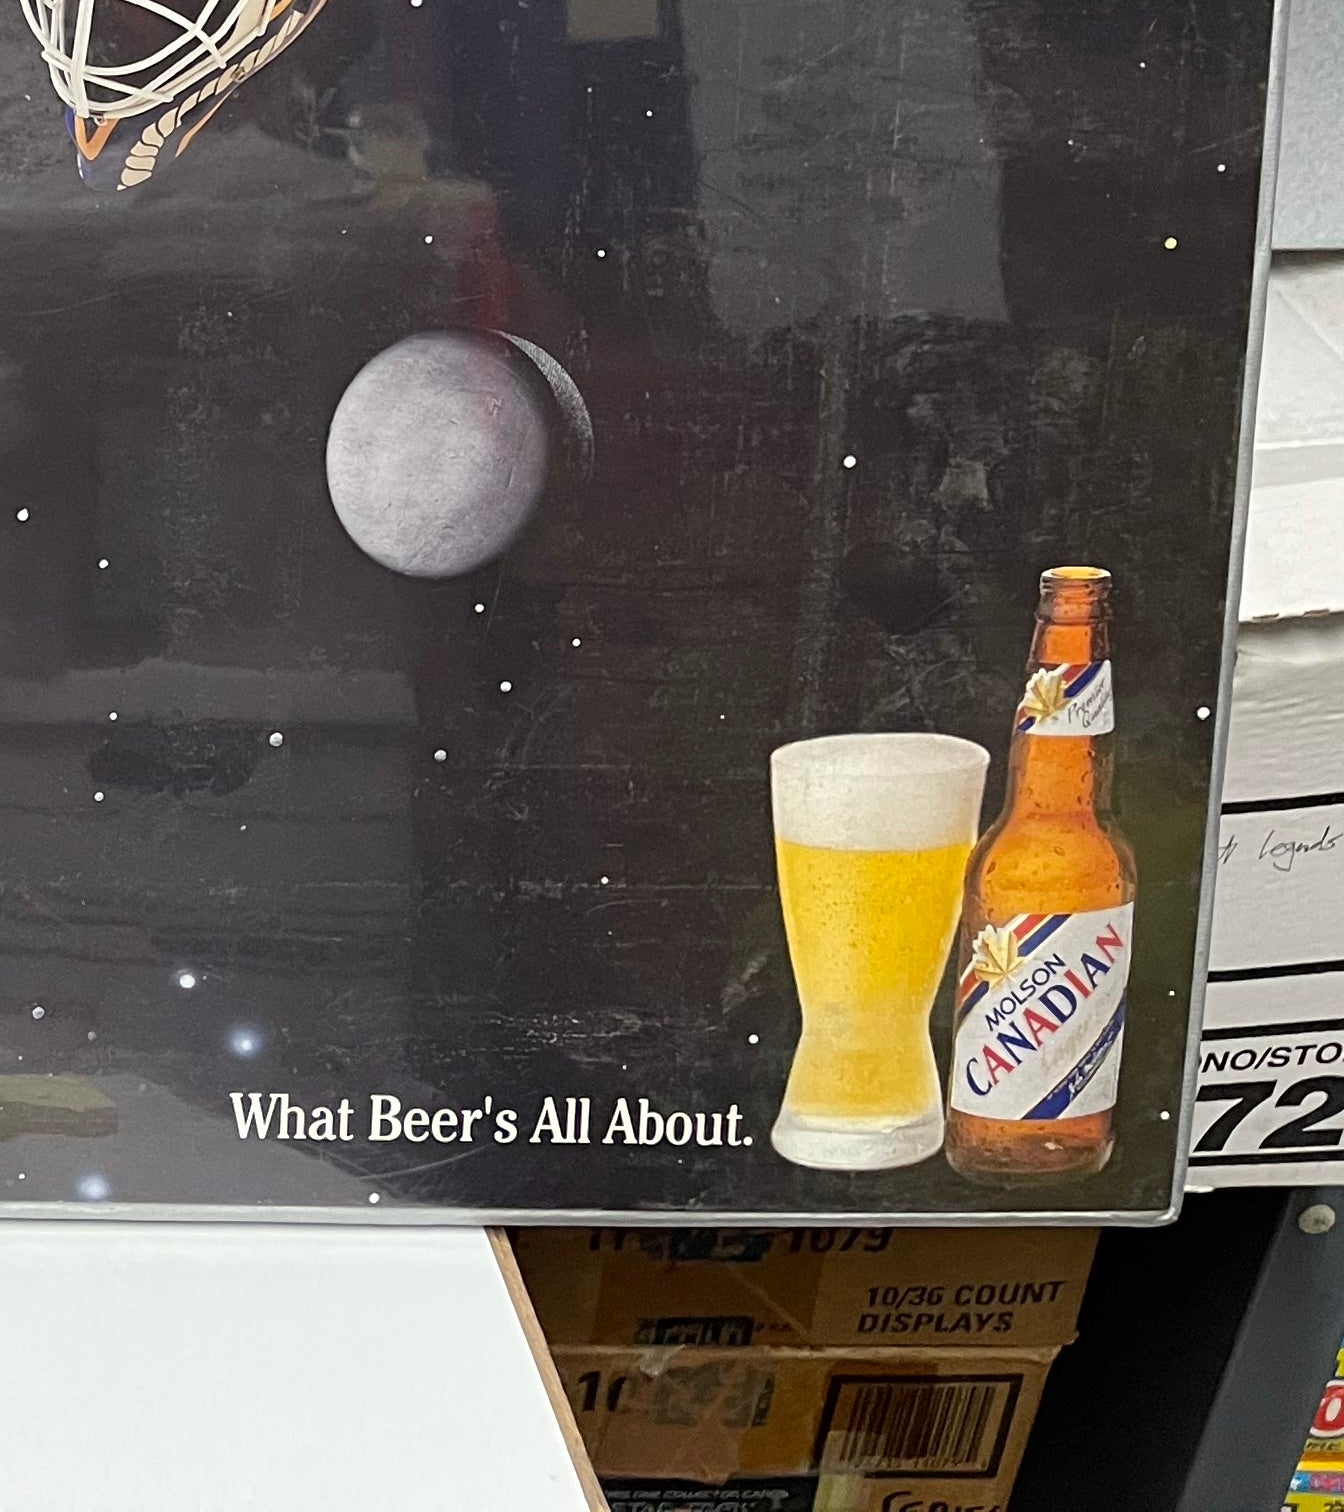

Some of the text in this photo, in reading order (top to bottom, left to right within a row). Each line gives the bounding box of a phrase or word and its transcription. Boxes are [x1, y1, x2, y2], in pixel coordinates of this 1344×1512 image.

[965, 921, 1125, 1096] CANADIAN
[984, 952, 1067, 1032] MOLSON
[1199, 1043, 1344, 1073] NO/STO
[229, 1092, 753, 1147] What Beer's All About.
[868, 1280, 1066, 1309] 10/36 COUNT
[857, 1311, 1014, 1333] DISPLAYS
